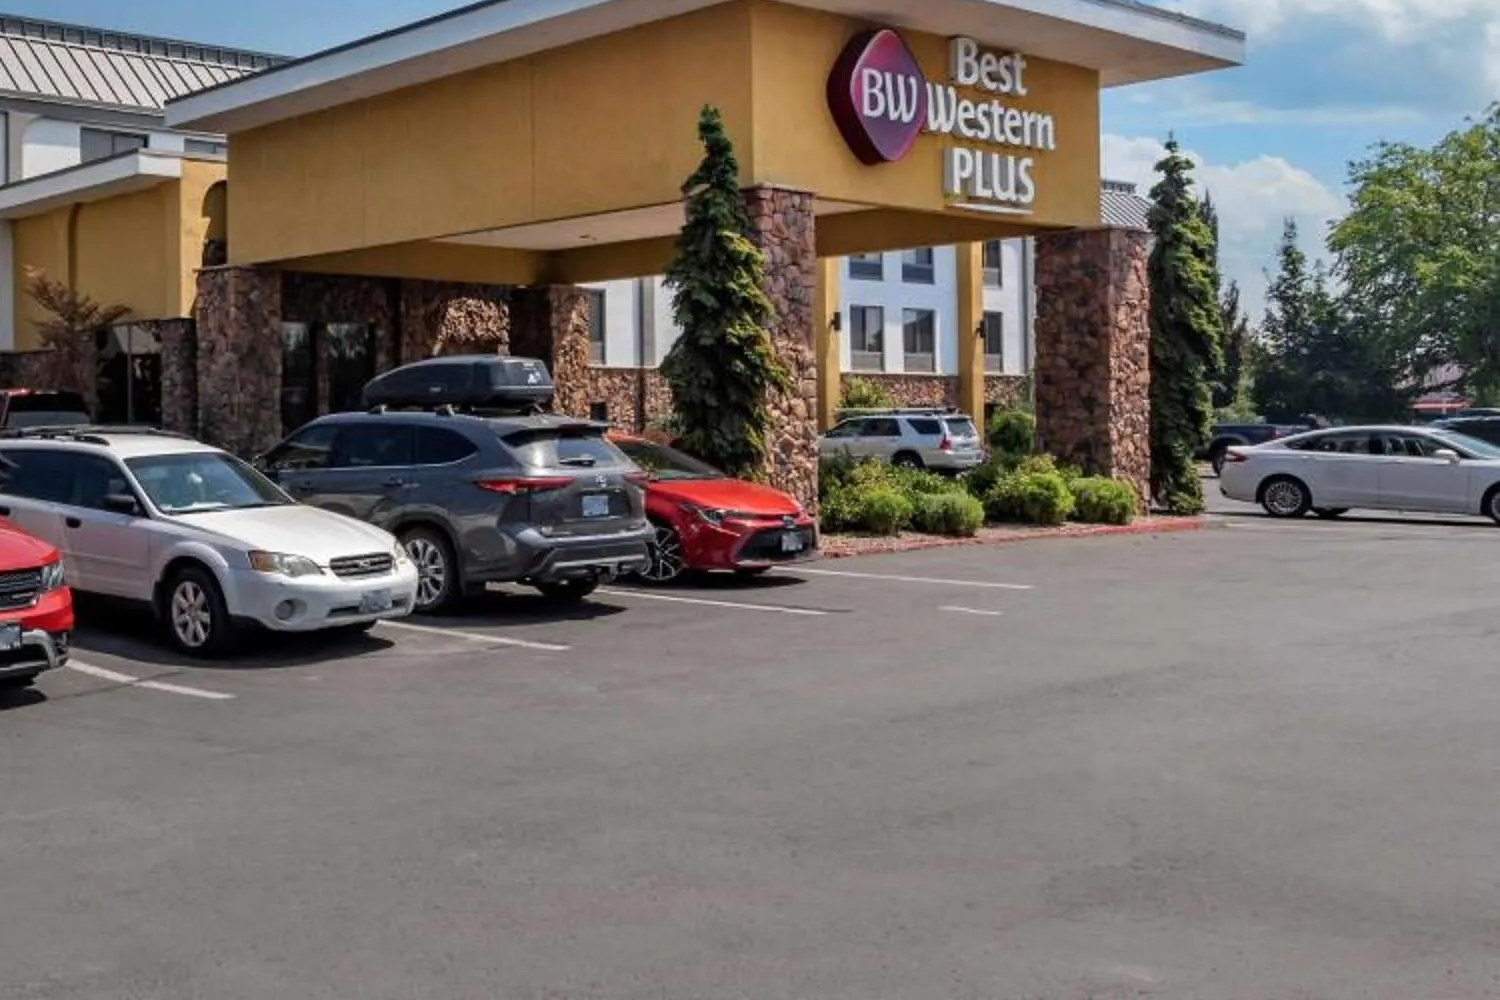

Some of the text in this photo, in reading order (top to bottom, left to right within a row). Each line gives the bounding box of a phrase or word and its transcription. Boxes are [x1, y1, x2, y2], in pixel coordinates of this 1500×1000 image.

[860, 67, 917, 123] BW
[954, 37, 1028, 97] Best
[926, 81, 1055, 150] Western
[950, 146, 1035, 204] PLUS
